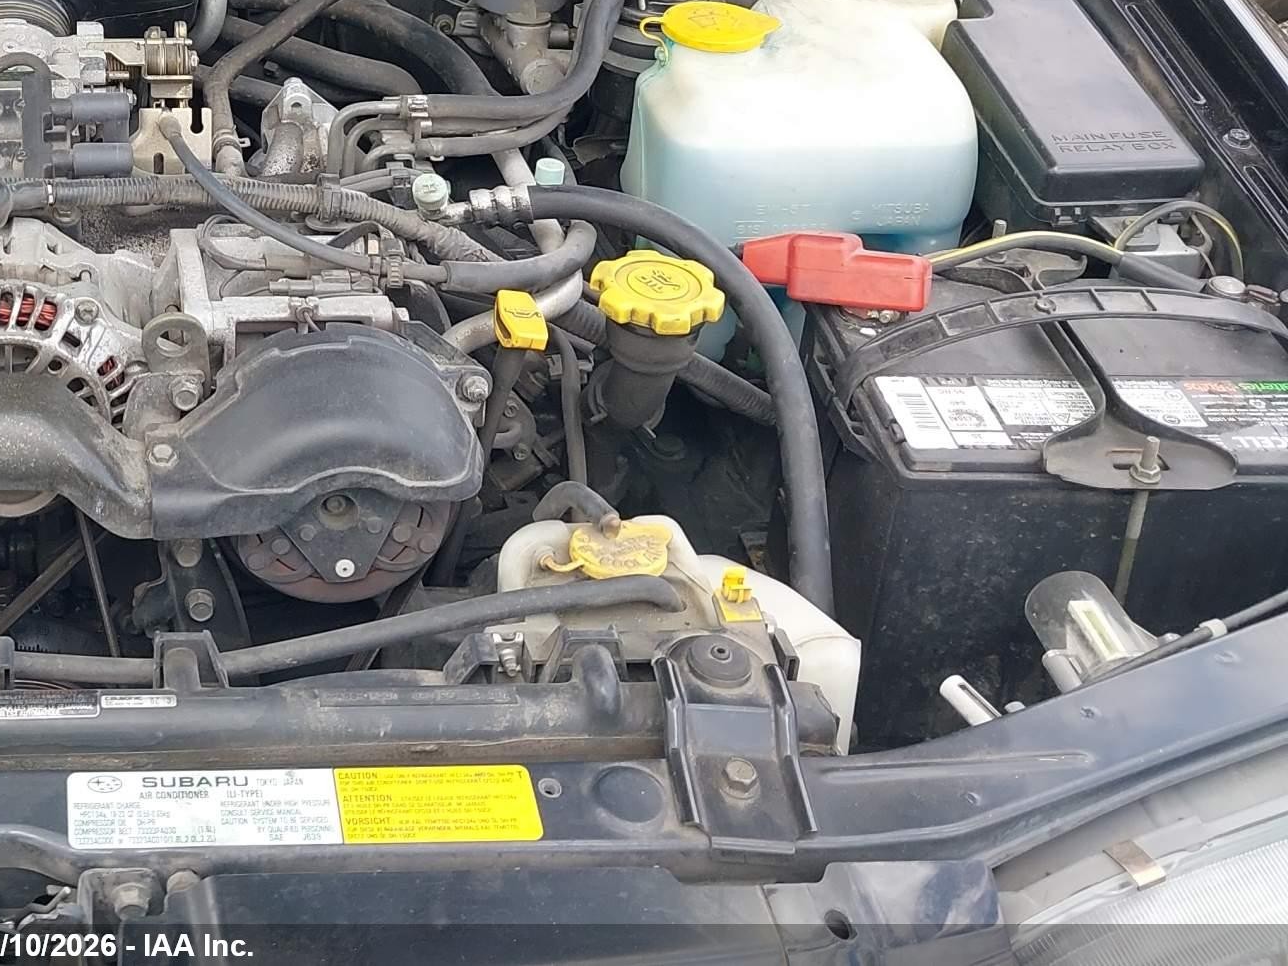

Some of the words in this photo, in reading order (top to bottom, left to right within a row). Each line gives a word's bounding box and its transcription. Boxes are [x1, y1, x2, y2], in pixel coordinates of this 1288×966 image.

[1051, 132, 1107, 142] MAIN
[1109, 131, 1167, 140] FUSE
[1059, 143, 1126, 153] RELAY
[1132, 142, 1177, 151] BOX
[338, 772, 378, 780] CAUTION
[142, 776, 249, 788] SUBARU
[139, 791, 153, 800] AIR
[155, 790, 209, 800] CONDITIONER
[343, 794, 393, 803] ATTENTION
[345, 816, 391, 825] VORSICHT
